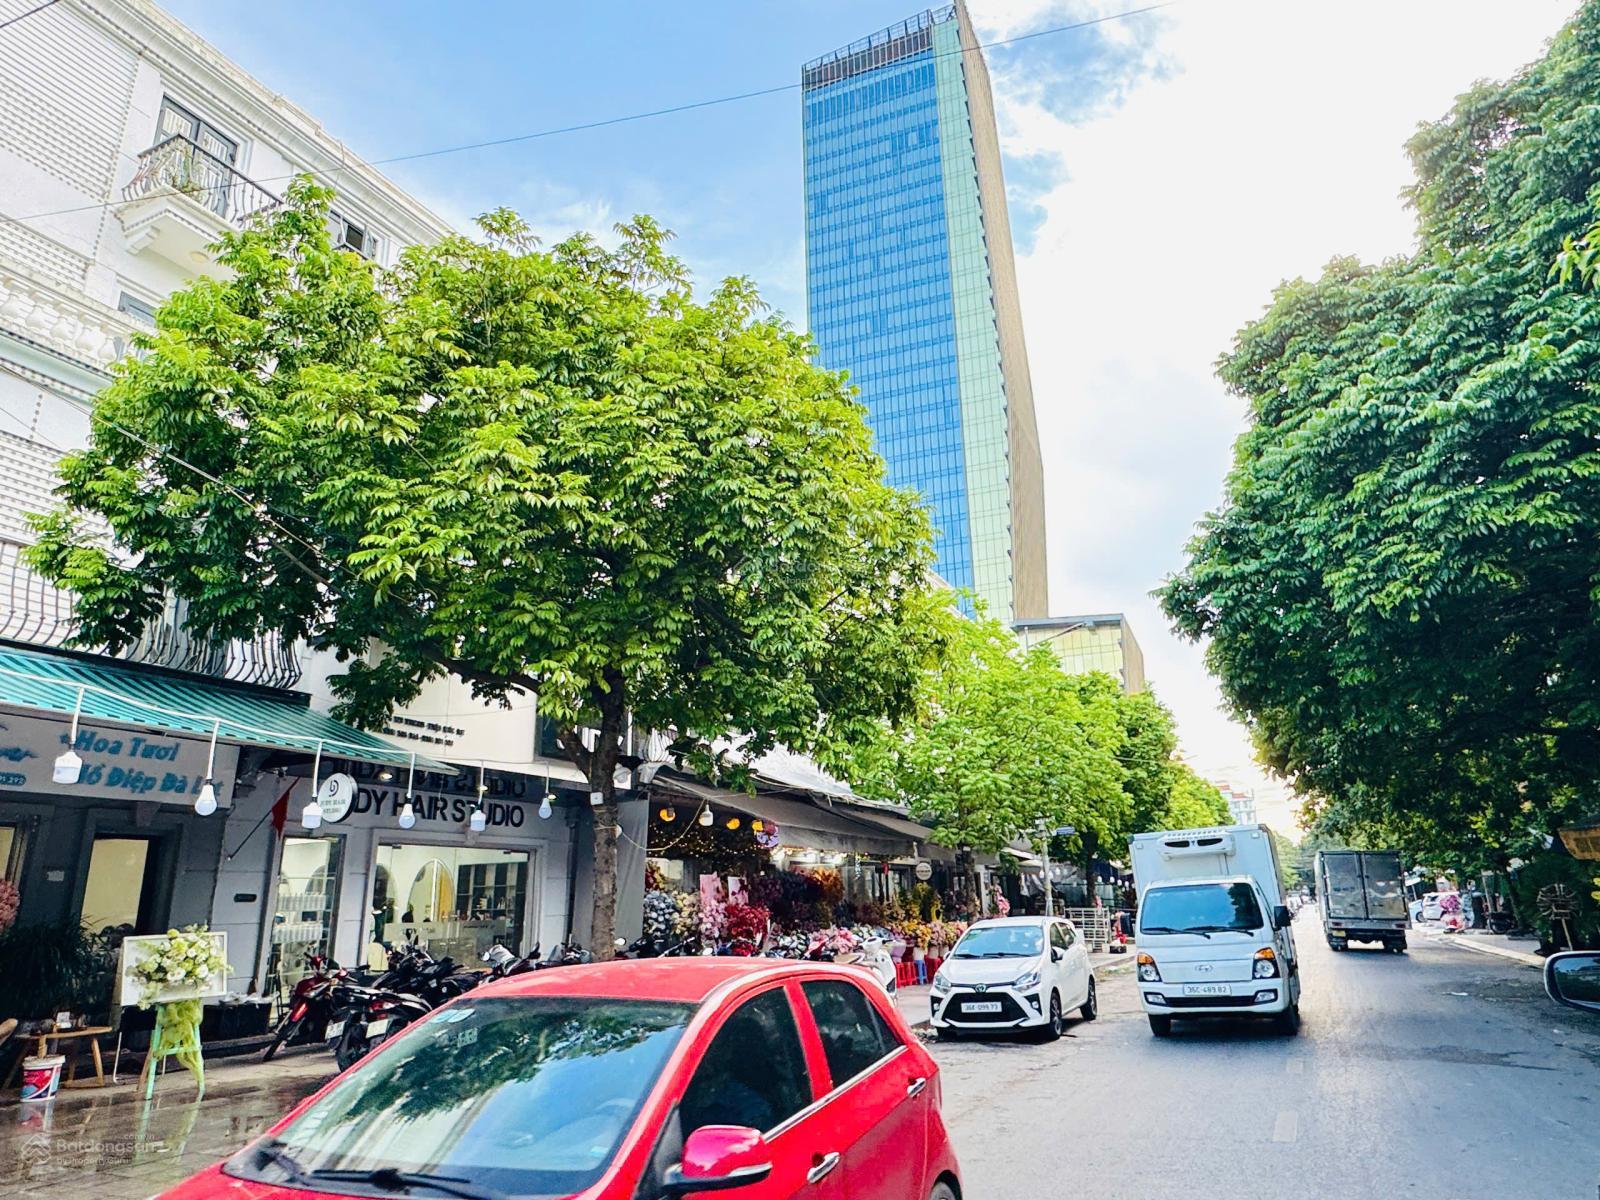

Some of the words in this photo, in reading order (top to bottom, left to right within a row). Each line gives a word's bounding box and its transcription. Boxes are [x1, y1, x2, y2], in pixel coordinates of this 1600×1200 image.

[75, 729, 123, 755] Hoa
[353, 788, 389, 815] DY
[393, 791, 448, 821] HAIR
[452, 798, 524, 827] STUDIO
